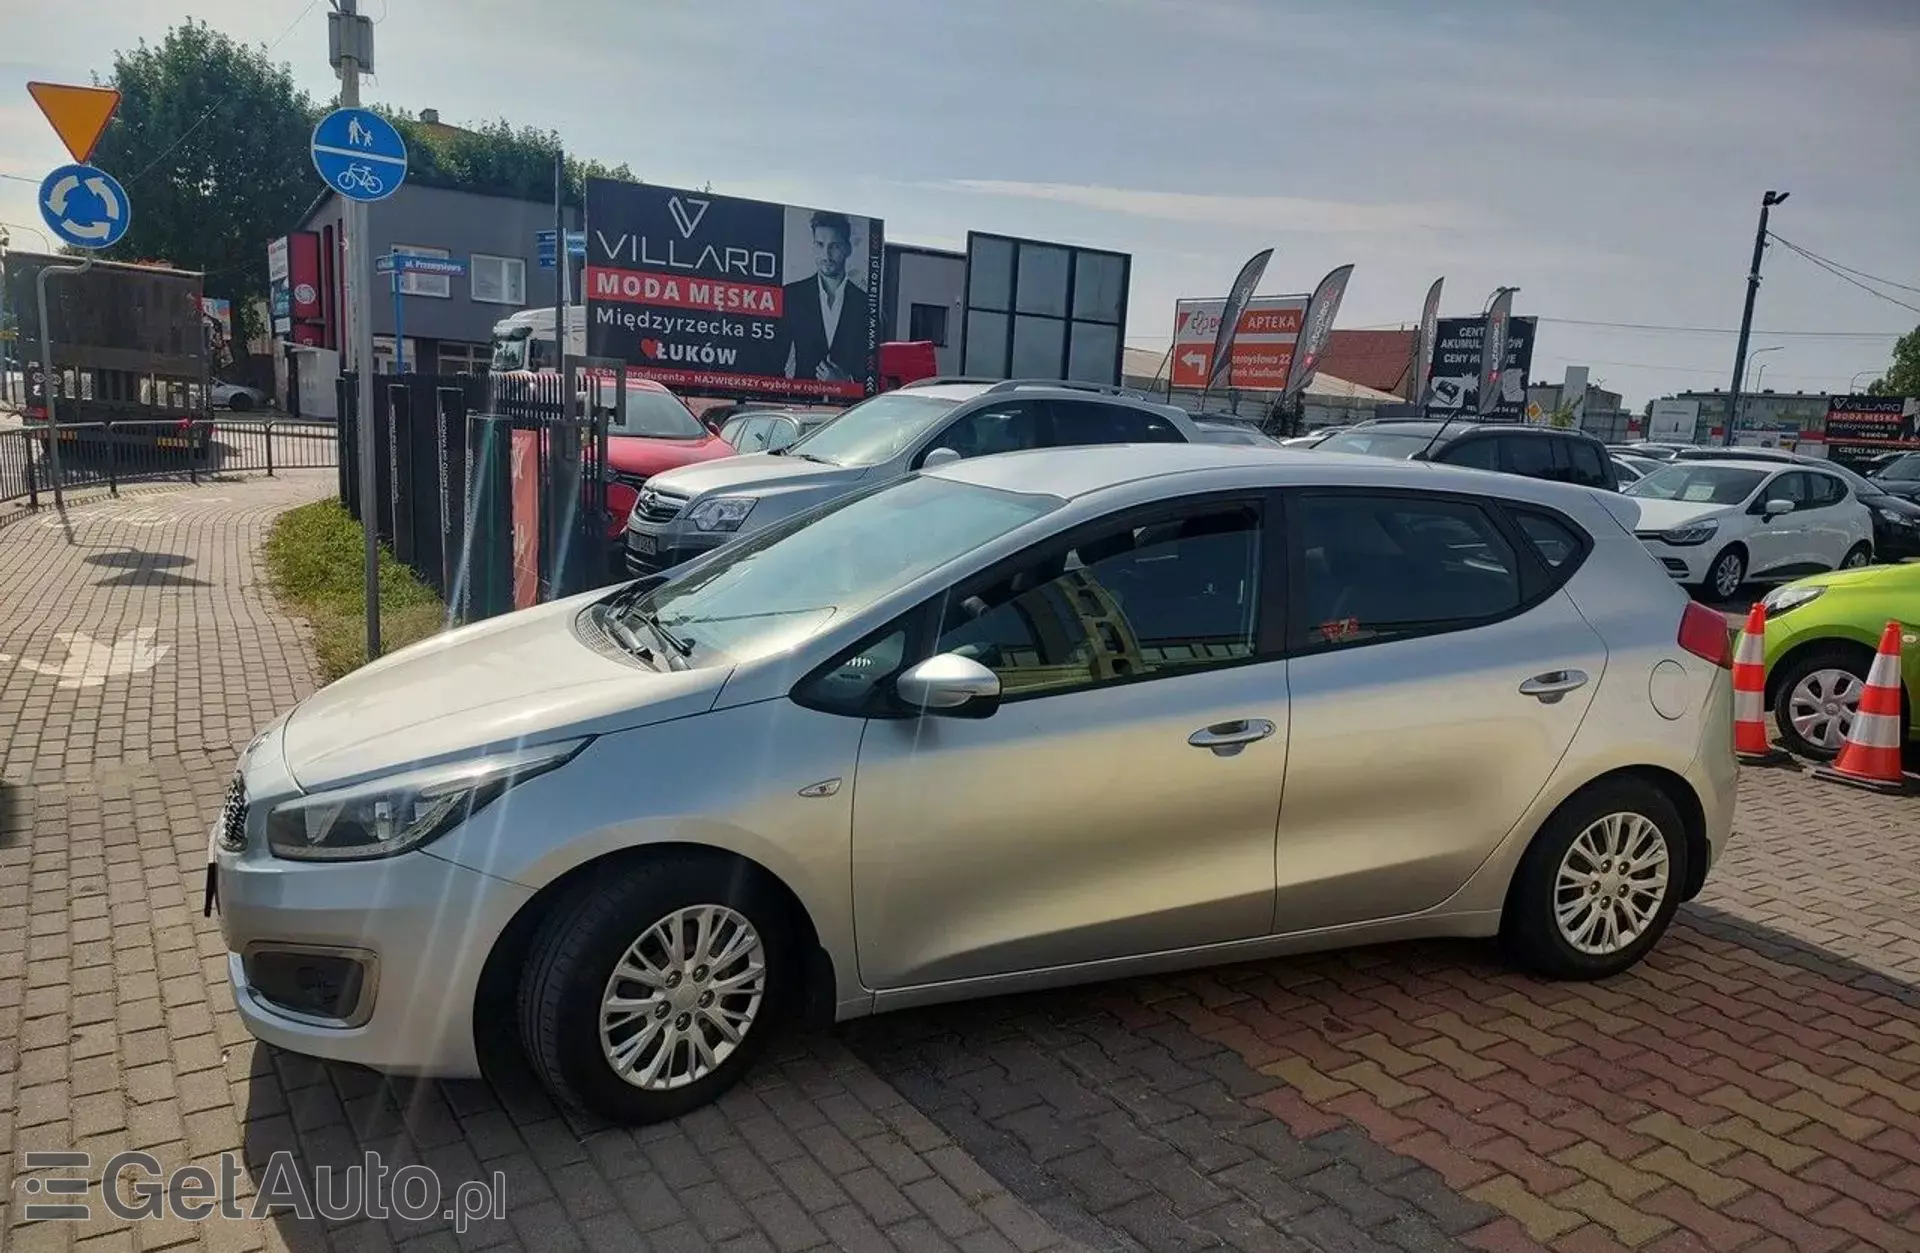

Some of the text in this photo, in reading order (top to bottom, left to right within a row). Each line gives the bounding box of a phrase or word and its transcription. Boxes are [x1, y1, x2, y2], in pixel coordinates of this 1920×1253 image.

[596, 230, 776, 278] VILLARO
[597, 272, 775, 312] MODA MĘSKA
[868, 256, 879, 350] www.villaro.pl
[597, 307, 775, 339] Międzyrzecka 55
[1248, 316, 1296, 329] APTEKA
[1459, 326, 1485, 337] CENT
[655, 343, 737, 366] ŁUKÓW
[1279, 353, 1293, 365] 22
[1443, 353, 1468, 364] CENY
[595, 368, 616, 377] CEN
[694, 375, 759, 388] NAJWIĘKSZY
[1846, 403, 1901, 412] VILLARO
